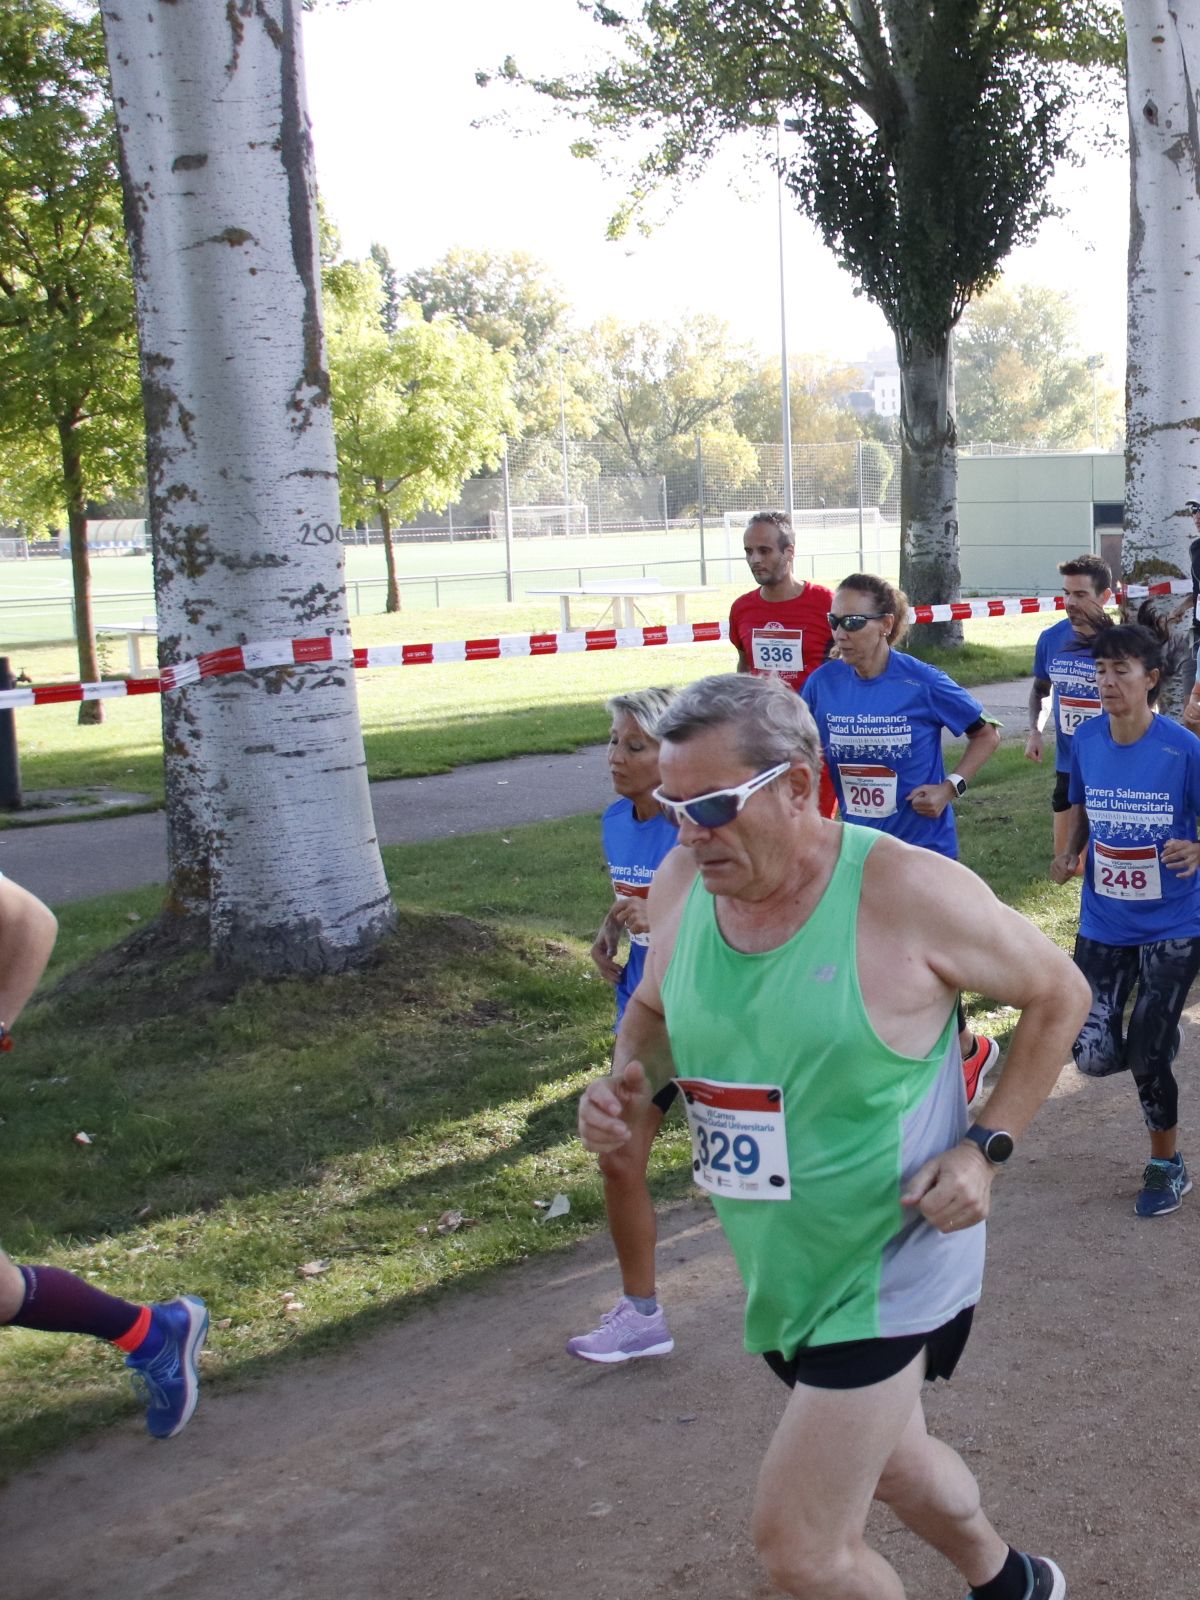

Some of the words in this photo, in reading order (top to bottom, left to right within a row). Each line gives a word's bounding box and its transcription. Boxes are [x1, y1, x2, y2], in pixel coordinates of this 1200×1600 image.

[760, 647, 793, 662] 336
[1052, 659, 1073, 667] Carrera
[1049, 666, 1067, 674] Ciudad
[826, 713, 854, 724] Carrera
[856, 713, 907, 723] Salamanca
[851, 723, 912, 734] Universitaria
[851, 786, 885, 807] 206
[1085, 785, 1113, 797] Carrera
[1116, 788, 1170, 800] Salamanca
[1110, 800, 1174, 813] Universitaria
[1101, 867, 1147, 889] 248
[713, 1111, 735, 1120] Carrera
[728, 1121, 775, 1132] Universitaria
[697, 1125, 760, 1175] 329
